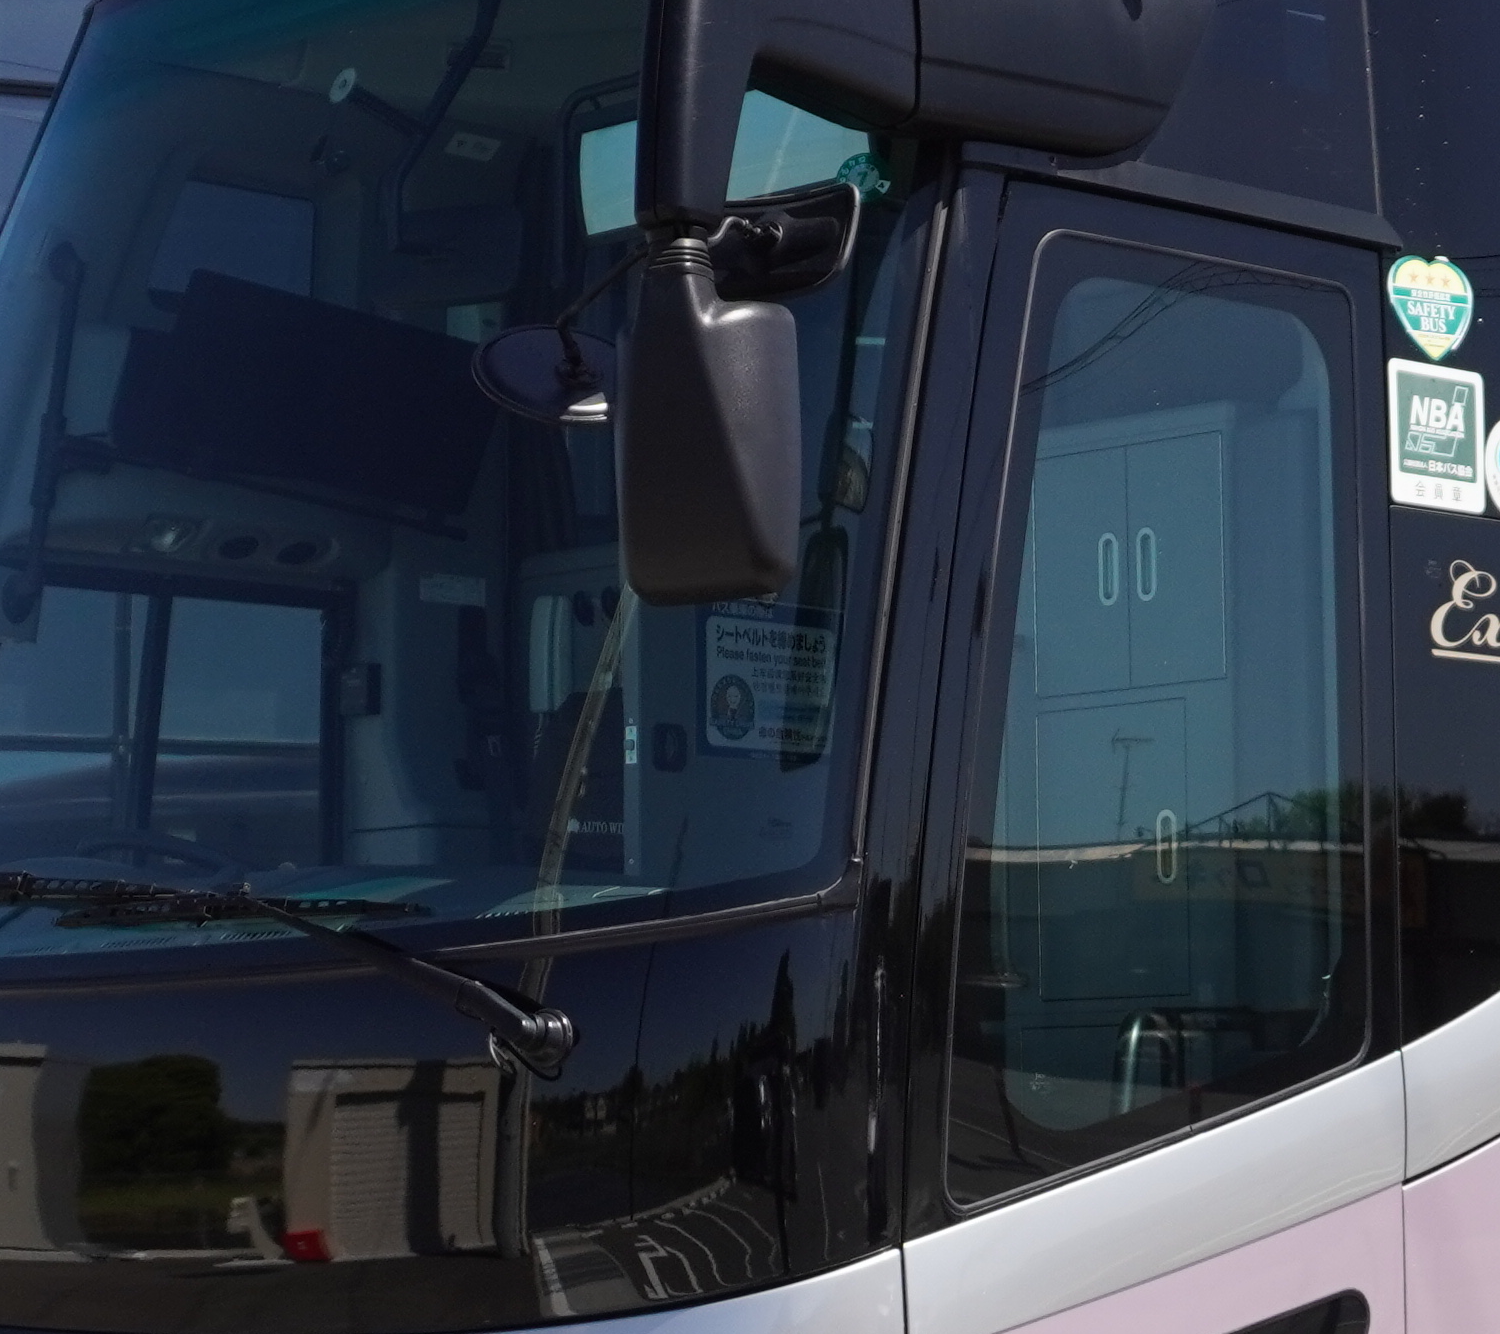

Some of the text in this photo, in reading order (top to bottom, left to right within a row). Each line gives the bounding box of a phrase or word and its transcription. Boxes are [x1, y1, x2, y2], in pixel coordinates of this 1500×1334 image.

[1407, 300, 1456, 321] SAFETY
[1421, 316, 1447, 333] BUS
[1409, 394, 1466, 433] NBA
[1428, 460, 1474, 478] 日本バス協会
